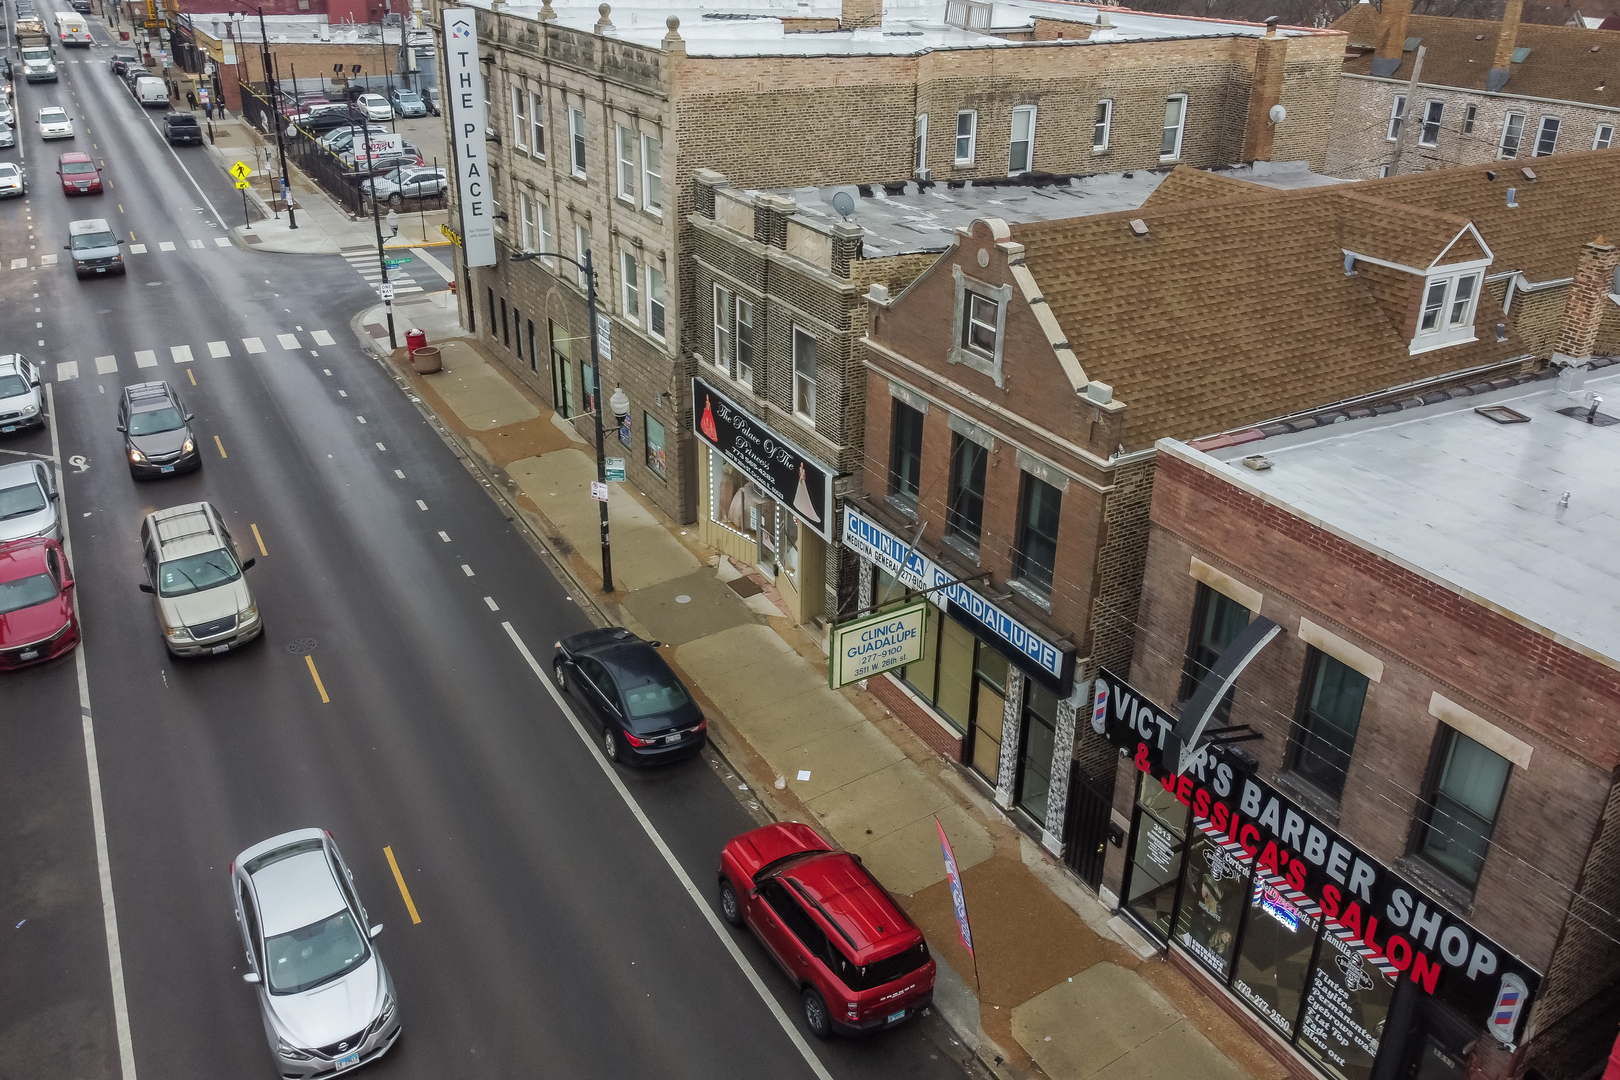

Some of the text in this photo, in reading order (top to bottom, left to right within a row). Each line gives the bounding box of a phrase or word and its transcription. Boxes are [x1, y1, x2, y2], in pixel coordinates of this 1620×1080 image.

[457, 52, 483, 217] THE PLACE
[716, 401, 794, 471] The Palace Of The
[732, 446, 745, 459] 773
[735, 435, 770, 470] Princess
[846, 532, 872, 558] MEDICINA
[874, 551, 900, 574] GENERAL
[849, 514, 924, 577] CLINICA
[861, 621, 904, 642] CLINICA
[935, 571, 1054, 669] GUADALUPE
[847, 627, 917, 658] GUADALUPE
[862, 645, 902, 665] 277-9100
[854, 666, 869, 677] 3511
[872, 663, 879, 671] W.
[882, 657, 897, 667] 26th
[1114, 685, 1497, 981] VICTR'S BARBER SHOP
[1153, 823, 1172, 841] 3513
[1135, 742, 1442, 996] & JESSICA'S SALON
[1225, 852, 1243, 872] Corte
[1322, 931, 1352, 957] familia
[1191, 938, 1224, 968] ENTRANCE
[1191, 944, 1223, 974] ENTRADA
[1314, 977, 1353, 1014] Rayitos
[1317, 967, 1350, 1000] Tintes
[1237, 979, 1290, 1031] 773-277-2550
[1312, 987, 1379, 1046] Permanentes
[1305, 1016, 1328, 1040] Fade
[1307, 995, 1378, 1058] Eyebrows wax
[1332, 1027, 1350, 1047] Top
[1302, 1024, 1346, 1067] Blow out
